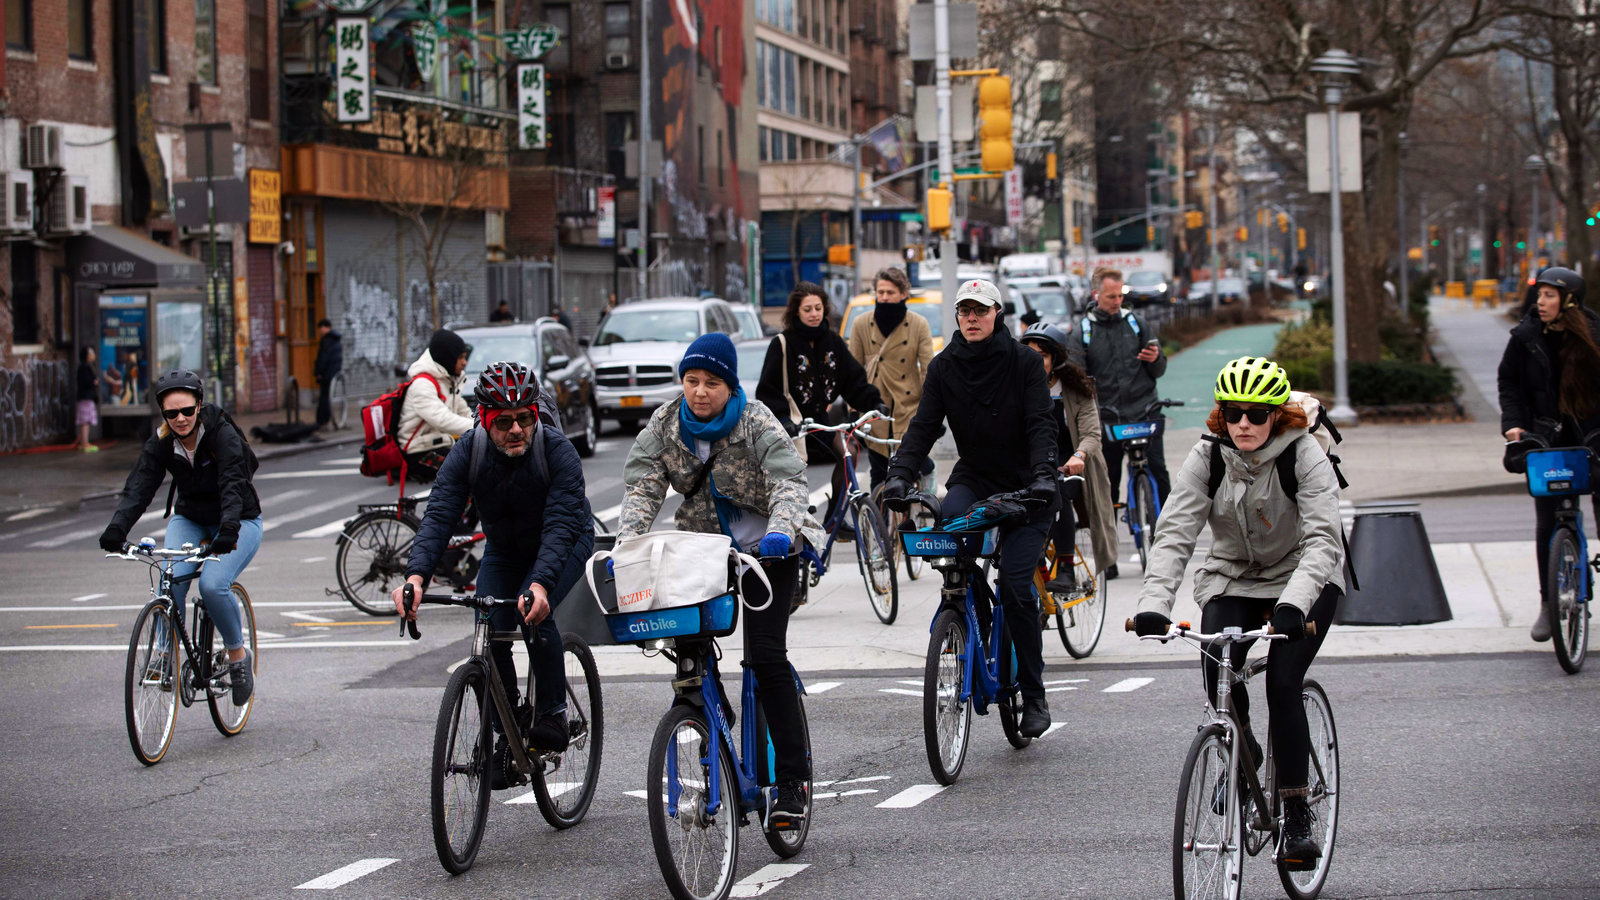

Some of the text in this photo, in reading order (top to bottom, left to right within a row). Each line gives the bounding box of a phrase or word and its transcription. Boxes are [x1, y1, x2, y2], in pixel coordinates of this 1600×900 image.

[339, 23, 364, 115] 粥之家
[521, 67, 542, 146] 粥之家
[629, 618, 677, 633] citi bike
